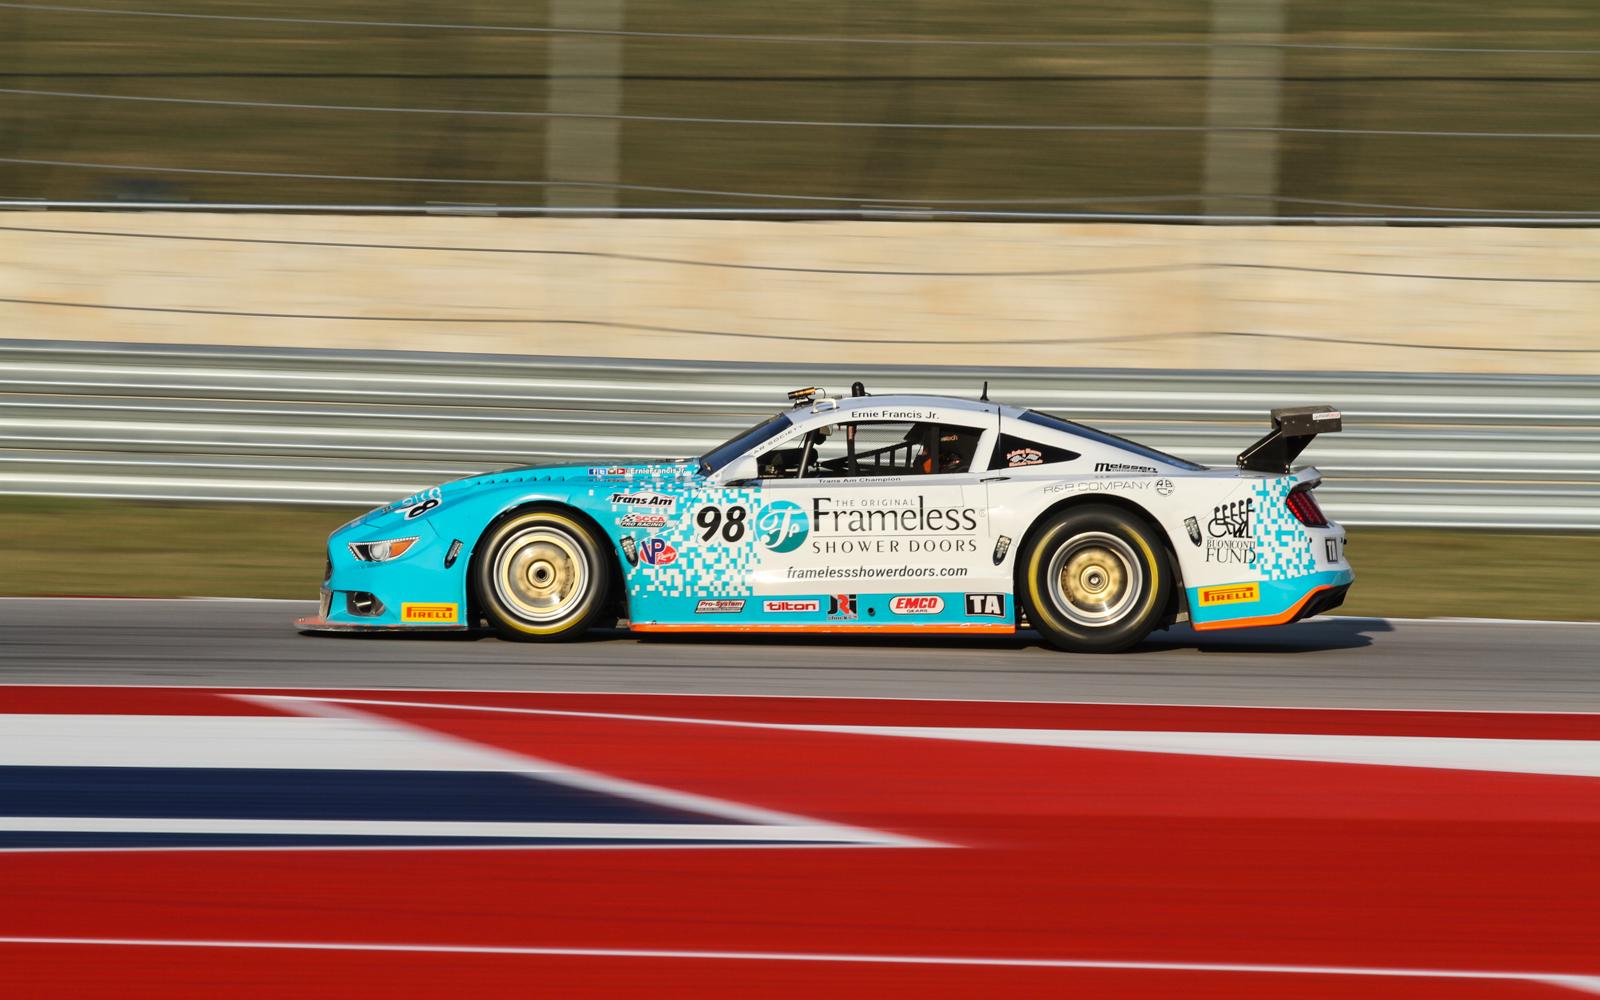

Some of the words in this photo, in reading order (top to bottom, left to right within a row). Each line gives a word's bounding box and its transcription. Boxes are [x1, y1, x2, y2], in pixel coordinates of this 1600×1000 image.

[851, 411, 878, 419] Ernie
[882, 411, 922, 419] Francis
[925, 411, 940, 420] Jr.
[1079, 481, 1152, 492] COMPANY
[612, 494, 647, 504] Trans
[648, 496, 673, 506] Am
[861, 498, 915, 506] ORIGINAL
[812, 495, 977, 532] Frameless
[697, 506, 747, 542] 98
[641, 538, 665, 564] VP
[812, 540, 899, 554] SHOWER
[909, 539, 977, 552] DOORS
[1206, 548, 1256, 563] FUND
[787, 565, 968, 579] framelessshowerdoors.com
[1204, 587, 1254, 602] PIRELLI
[767, 602, 816, 611] tilton
[896, 597, 938, 608] EMCO
[970, 595, 1001, 614] TA
[407, 606, 453, 618] PIRELLI
